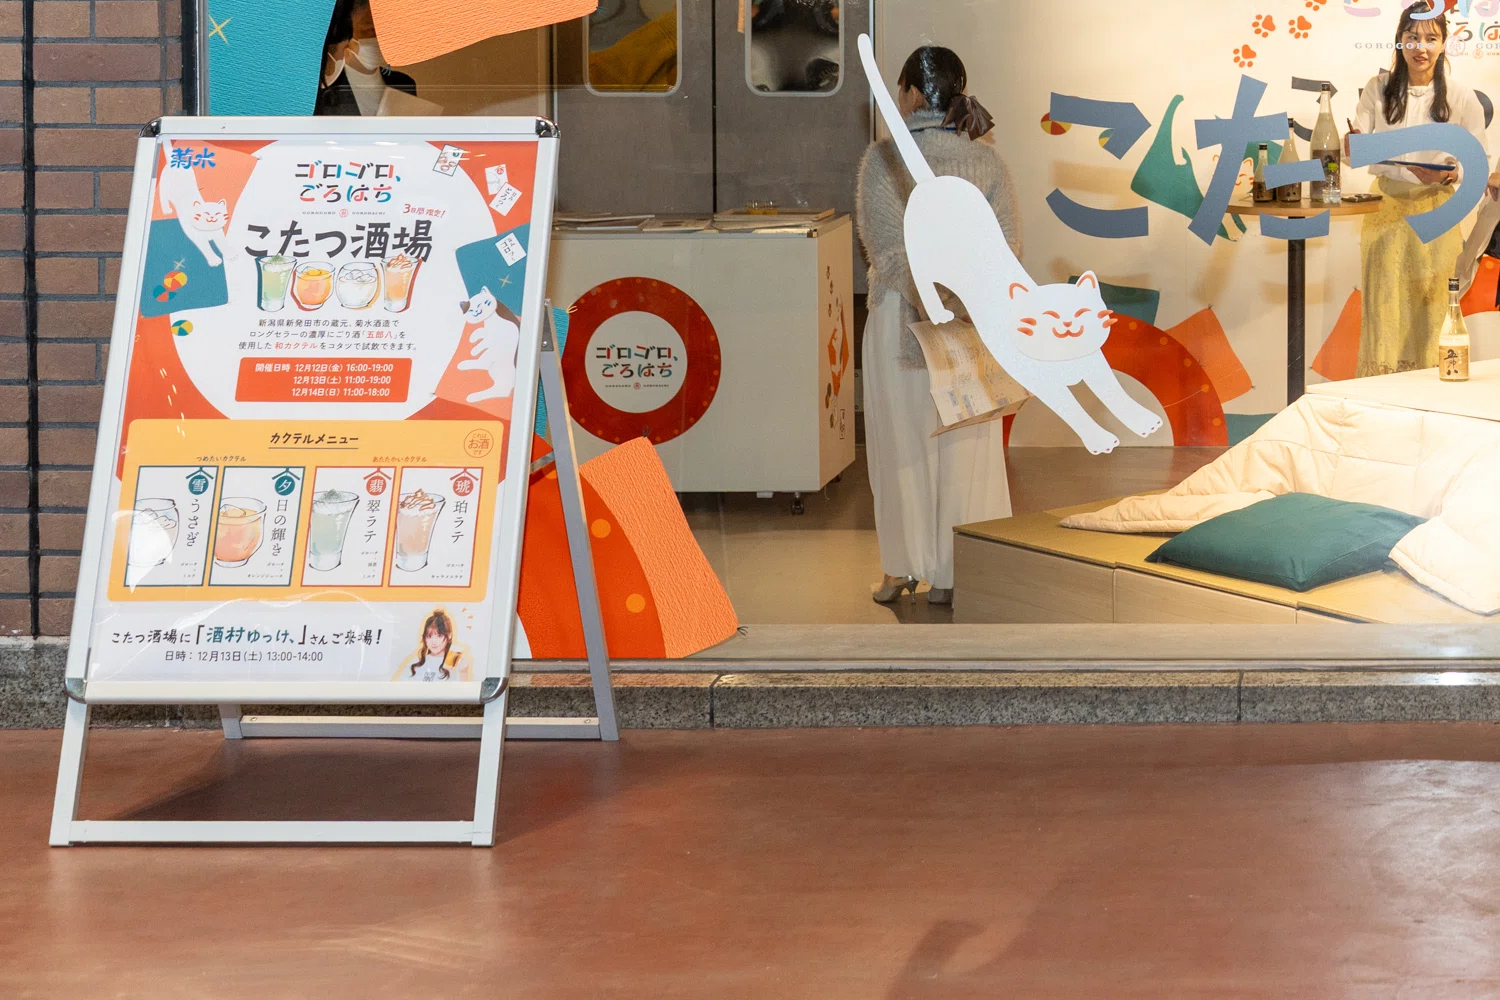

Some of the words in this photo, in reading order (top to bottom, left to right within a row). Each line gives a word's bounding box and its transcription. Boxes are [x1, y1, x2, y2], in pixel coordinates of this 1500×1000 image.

[1354, 42, 1435, 50] GOROGORO
[171, 147, 216, 170] 菊水
[295, 160, 401, 182] ゴロゴロ、
[299, 184, 393, 203] ごろはち
[245, 219, 433, 263] こたつ酒場
[595, 343, 678, 362] ゴロゴロ、
[255, 363, 291, 373] 開催日時
[346, 363, 394, 373] 16:00-19:00
[601, 363, 673, 378] ごろはち
[344, 375, 392, 385] 11:00-19:00
[343, 387, 390, 397] 11:00-18:00
[269, 432, 360, 445] カクテルメニュー
[468, 438, 490, 450] お酒
[196, 455, 247, 463] つめたいカクテル
[186, 478, 206, 547] 雪うさぎ
[266, 651, 324, 662] 13:00-14:00
